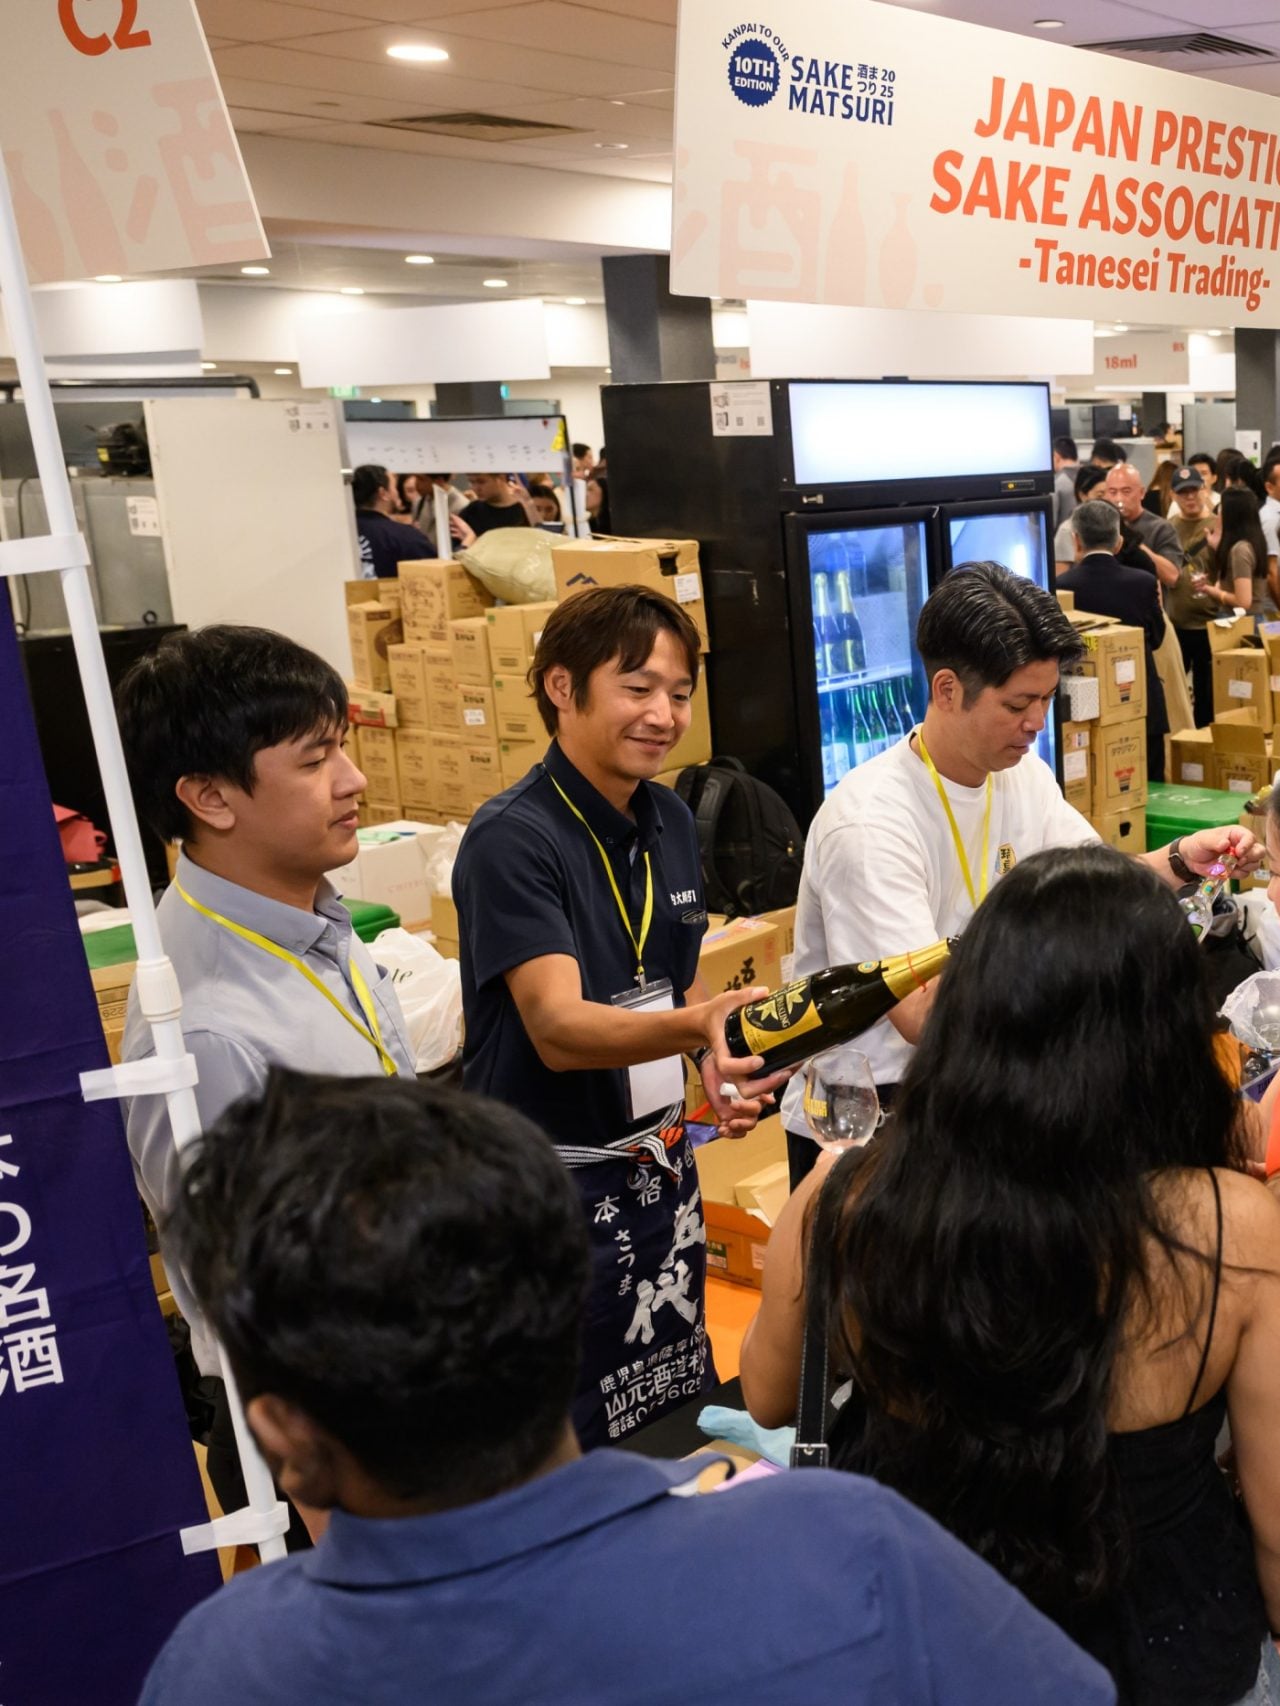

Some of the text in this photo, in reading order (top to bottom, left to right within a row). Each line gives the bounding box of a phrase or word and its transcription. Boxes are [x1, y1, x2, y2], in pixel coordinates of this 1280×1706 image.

[58, 0, 152, 56] C2
[722, 23, 790, 62] KANPAI TO OUR
[734, 56, 775, 78] 10TH
[734, 76, 774, 92] EDITION
[791, 55, 853, 91] SAKE
[881, 69, 896, 82] 20
[788, 84, 894, 126] MATSURI
[880, 84, 894, 98] 25
[974, 76, 1144, 162] JAPAN
[929, 149, 1071, 227] SAKE
[1018, 237, 1271, 312] -Tanesei Trading-
[1105, 354, 1137, 369] 18ml
